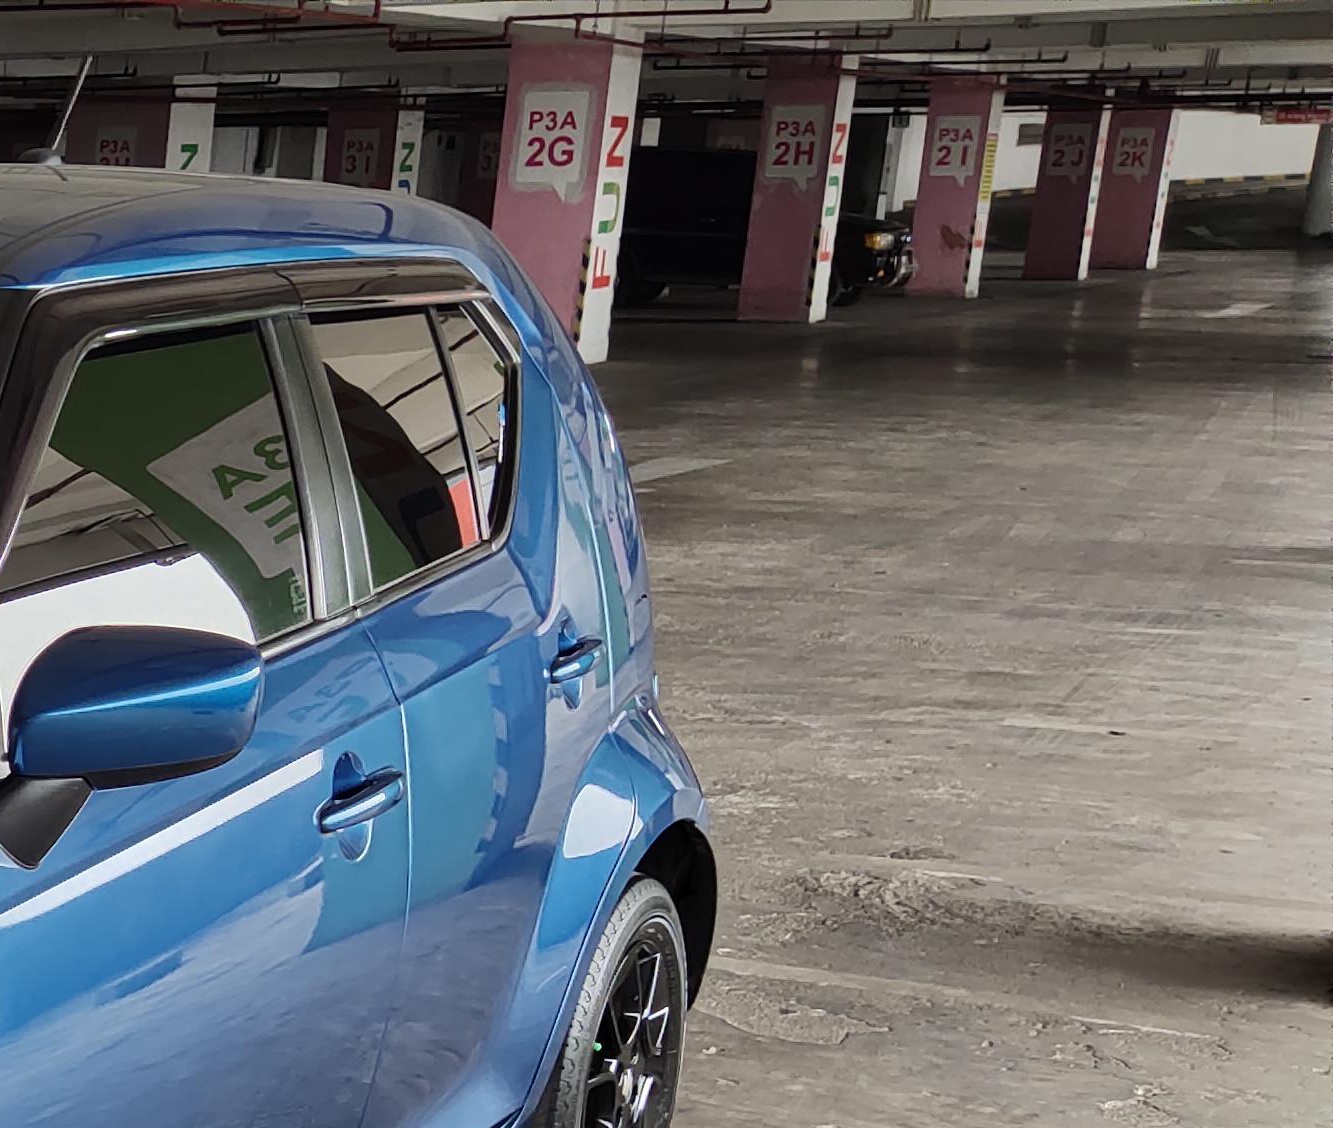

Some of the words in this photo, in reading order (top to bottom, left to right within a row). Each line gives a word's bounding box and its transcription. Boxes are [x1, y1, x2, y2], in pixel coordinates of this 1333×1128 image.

[528, 111, 577, 131] P3A
[776, 121, 816, 137] P3A
[938, 128, 973, 142] P3A
[99, 140, 130, 154] P3A
[524, 136, 575, 167] 2G
[773, 141, 815, 166] 2H
[1117, 151, 1146, 167] 2K
[591, 115, 629, 290] FUN
